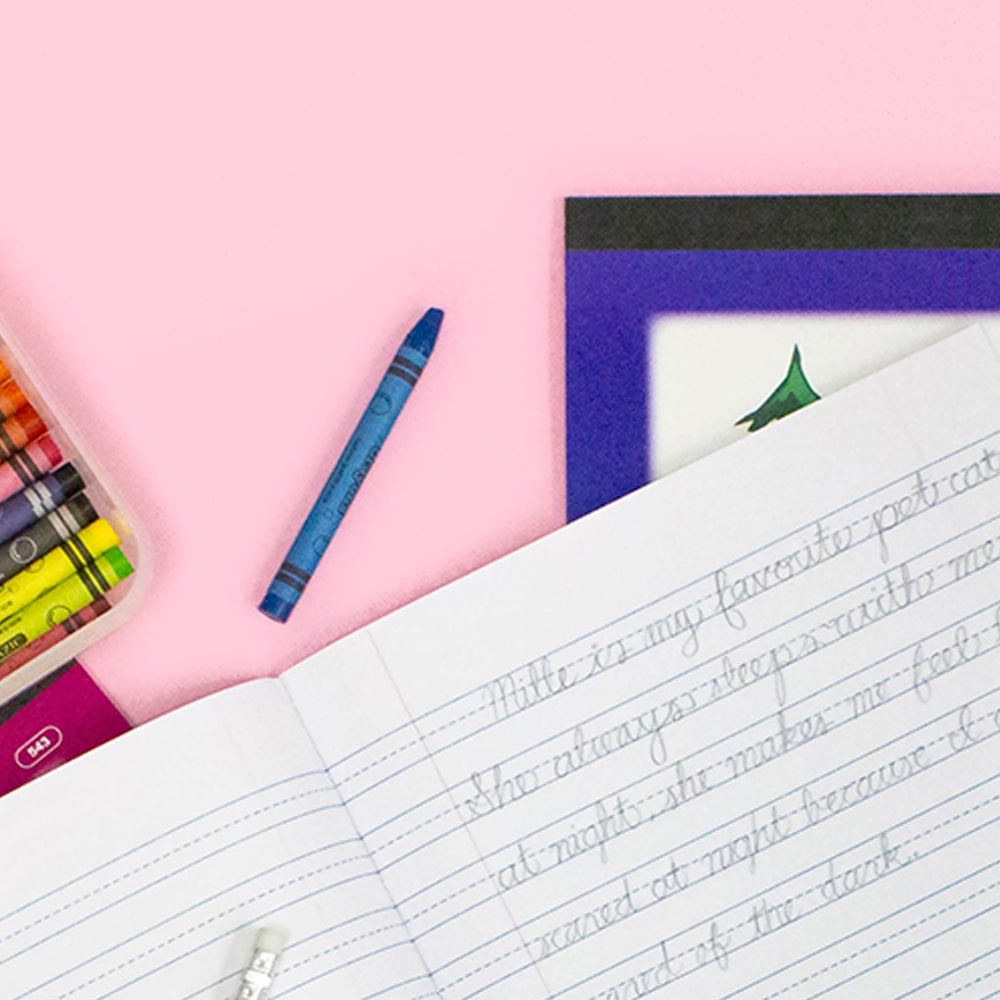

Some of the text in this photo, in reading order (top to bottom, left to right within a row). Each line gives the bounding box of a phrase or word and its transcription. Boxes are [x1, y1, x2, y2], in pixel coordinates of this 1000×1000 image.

[644, 606, 703, 658] my
[713, 519, 853, 631] favorite
[868, 470, 940, 564] pet
[27, 735, 52, 758] 543
[465, 764, 539, 815] She
[554, 692, 696, 766] always
[711, 633, 827, 706] sleeps
[831, 563, 934, 638] with
[498, 843, 541, 890] at
[664, 762, 710, 810] she
[727, 711, 834, 778] makes
[850, 681, 888, 718] me
[913, 625, 981, 704] feel
[533, 878, 640, 958] scared
[651, 857, 689, 900] at
[705, 806, 790, 875] night
[801, 745, 931, 825] because
[695, 921, 731, 971] of
[749, 898, 797, 936] the
